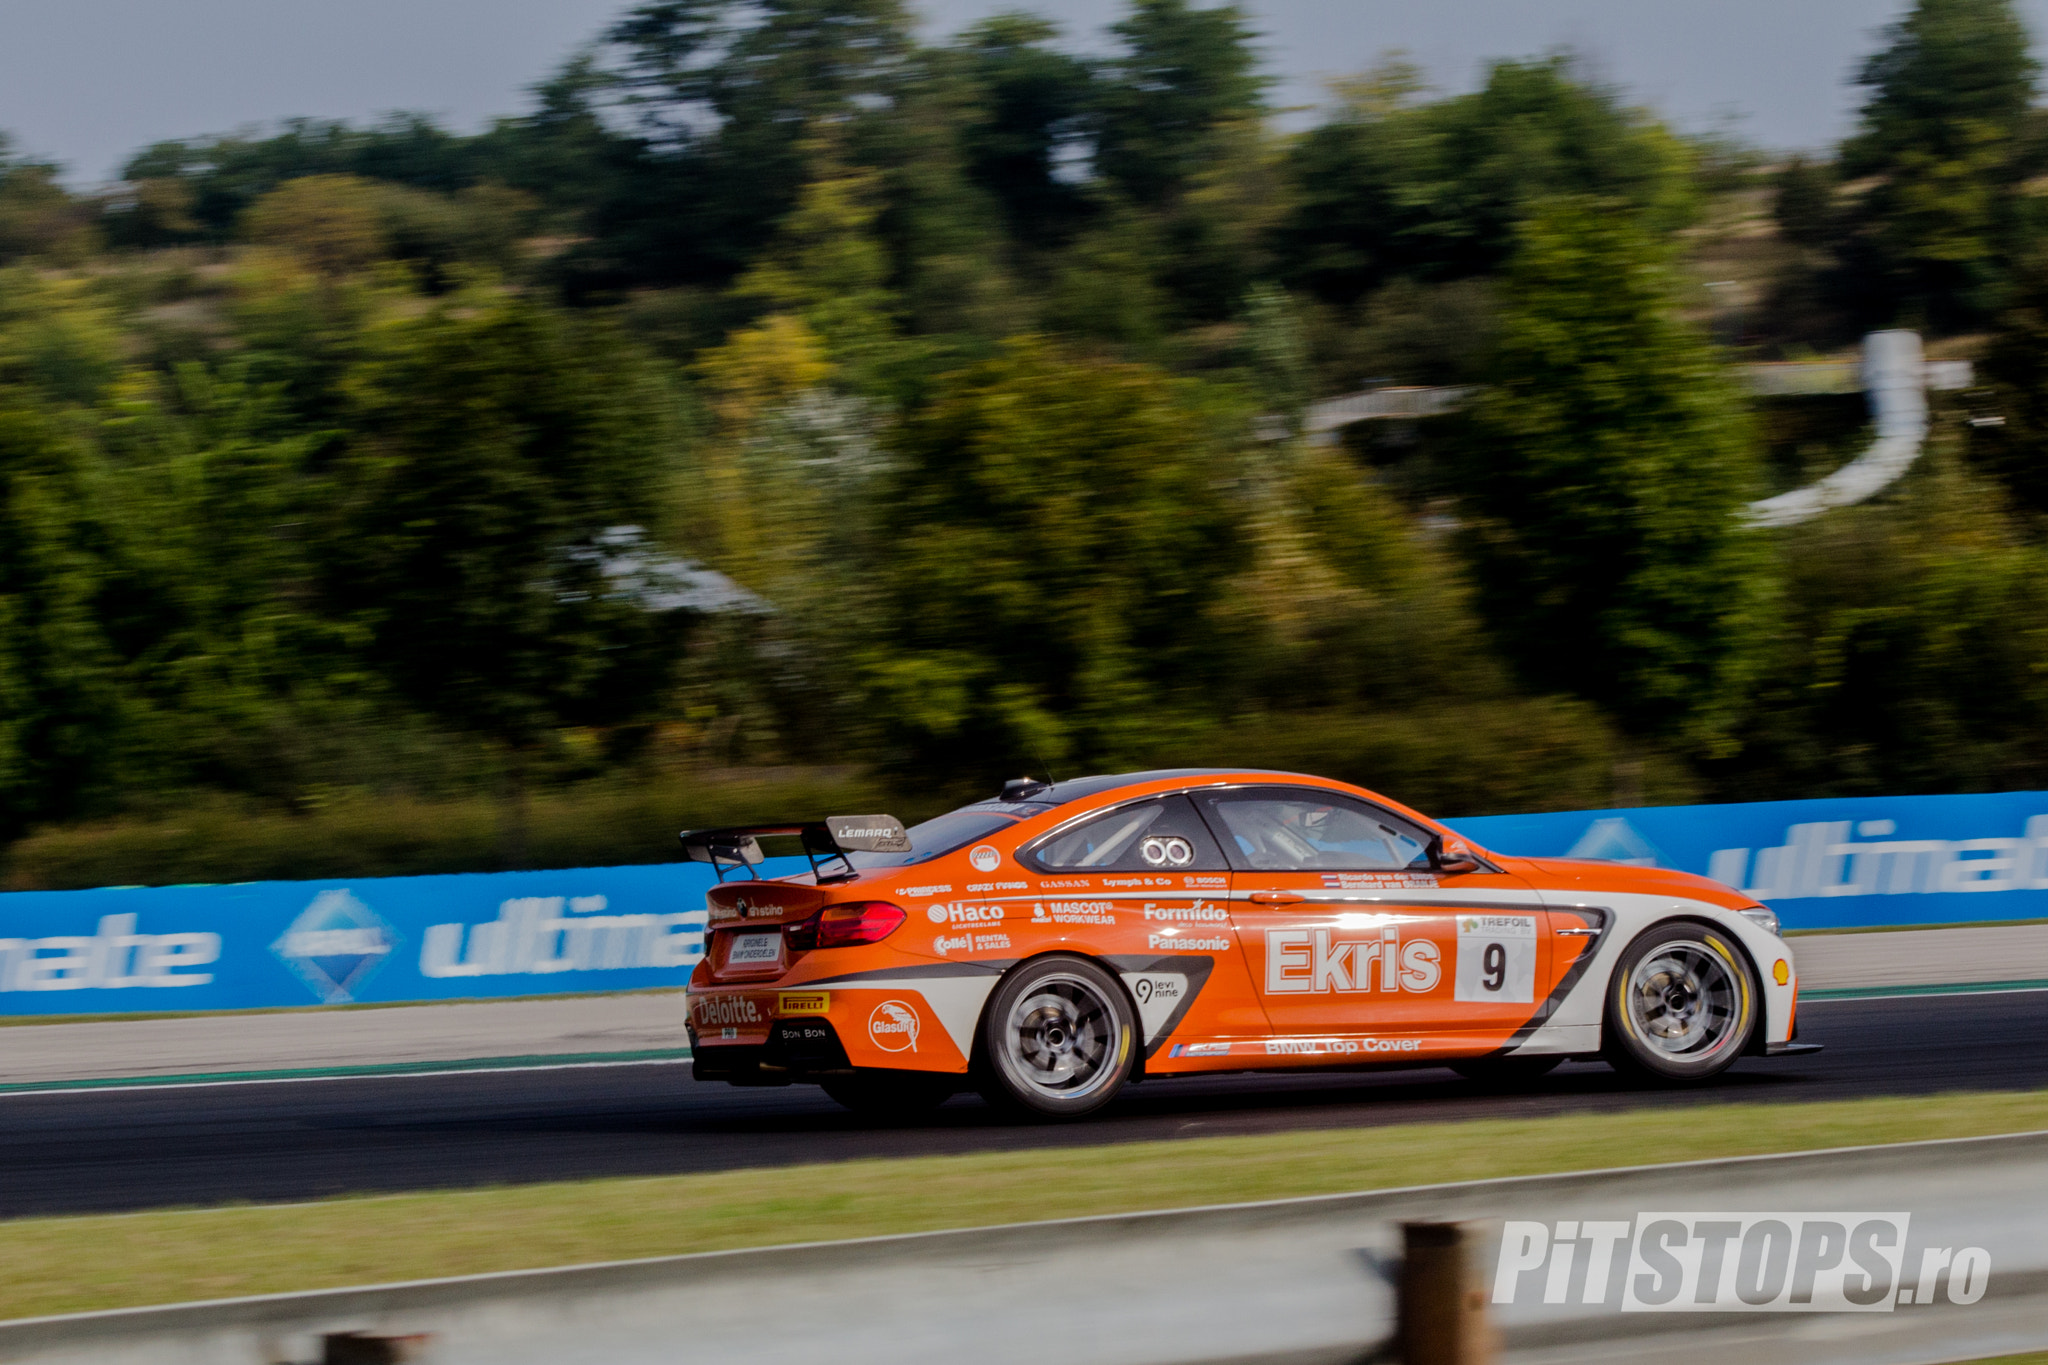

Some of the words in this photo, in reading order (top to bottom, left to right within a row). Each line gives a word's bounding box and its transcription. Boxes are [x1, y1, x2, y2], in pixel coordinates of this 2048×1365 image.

[1040, 880, 1090, 888] GASSAN
[1102, 878, 1142, 887] Lymph
[948, 903, 1004, 922] Haco
[1144, 900, 1227, 921] Formido
[1053, 914, 1115, 925] WORKWEAR
[1481, 917, 1531, 927] TREFOIL
[975, 934, 1009, 943] RENTAL
[1148, 934, 1230, 950] Panasonic
[984, 940, 1011, 949] SALES
[1265, 926, 1442, 995] Ekris
[1483, 943, 1506, 991] 9
[1155, 980, 1174, 990] levi
[1155, 989, 1178, 998] nine
[783, 996, 824, 1010] PIRELLI
[1265, 1041, 1316, 1055] BMW
[1322, 1040, 1359, 1055] Top
[1363, 1038, 1422, 1052] Cover
